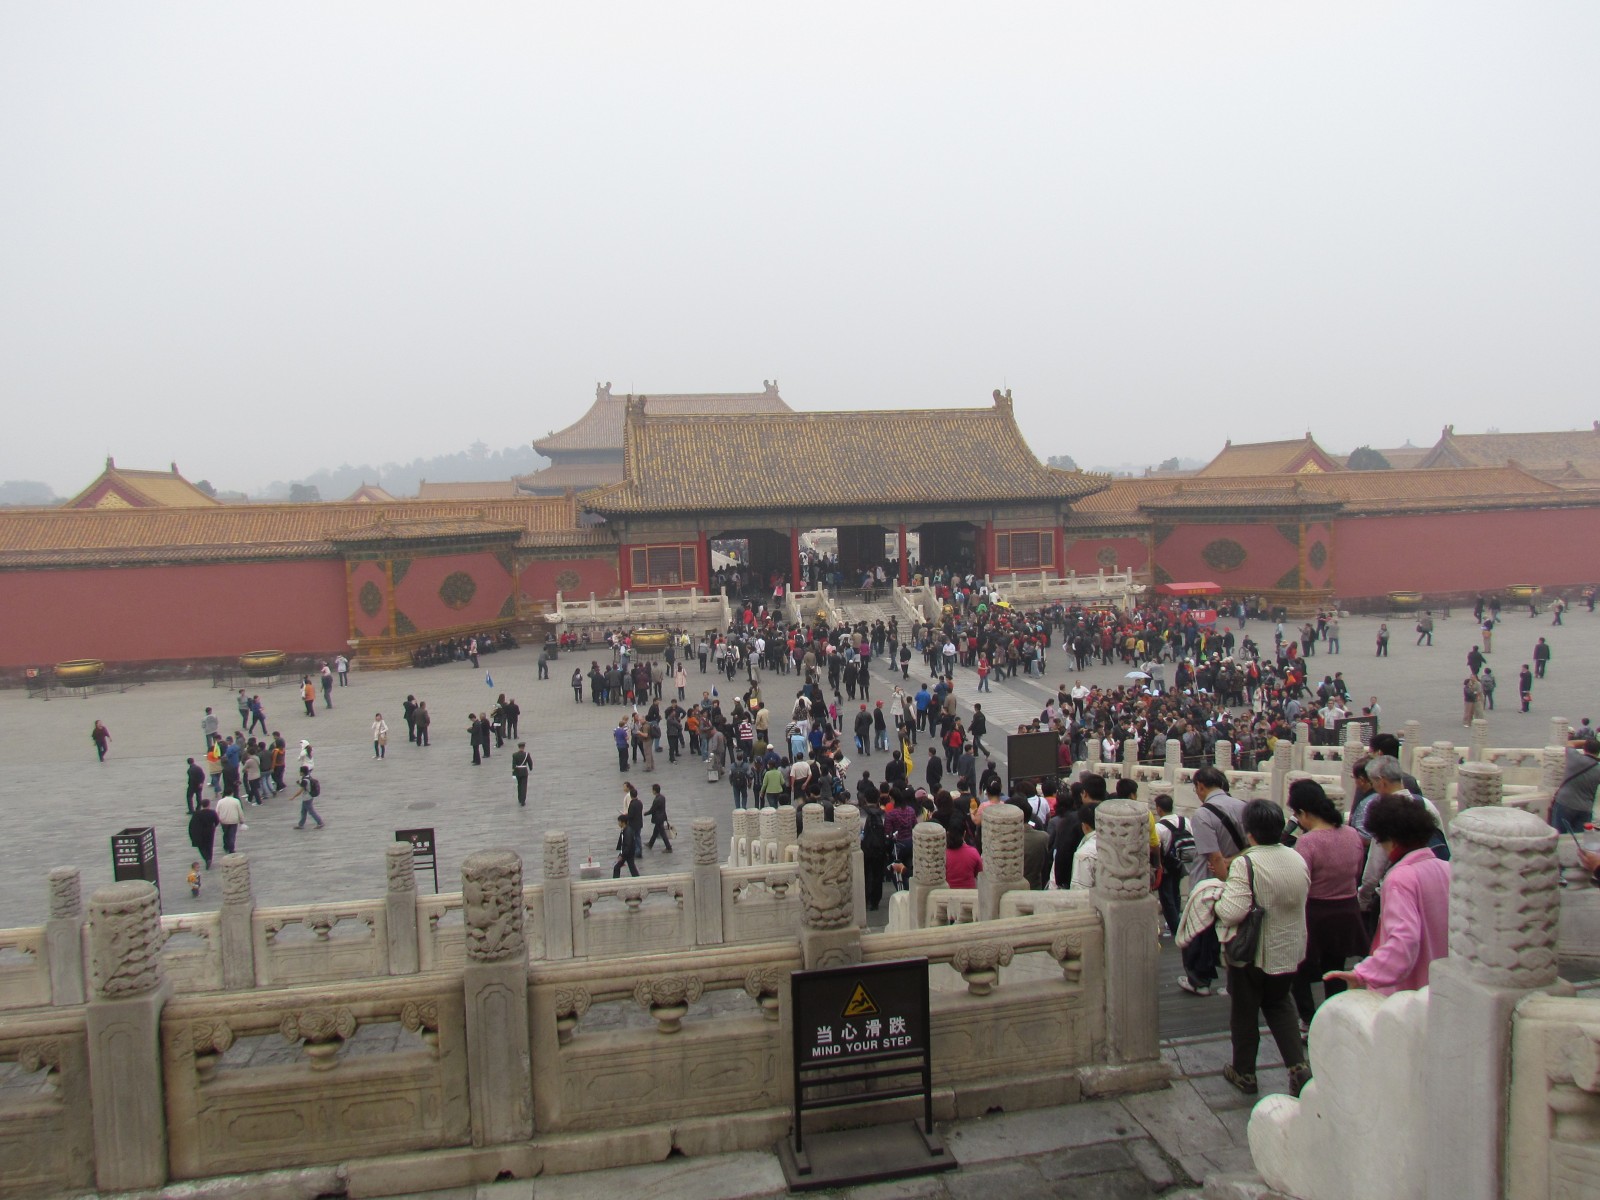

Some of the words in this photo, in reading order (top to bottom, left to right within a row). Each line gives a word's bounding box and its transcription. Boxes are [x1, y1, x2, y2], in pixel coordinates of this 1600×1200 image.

[817, 1016, 906, 1043] 当心滑跌
[812, 1045, 841, 1057] MIND
[846, 1040, 878, 1052] YOUR
[883, 1036, 912, 1048] STEP
